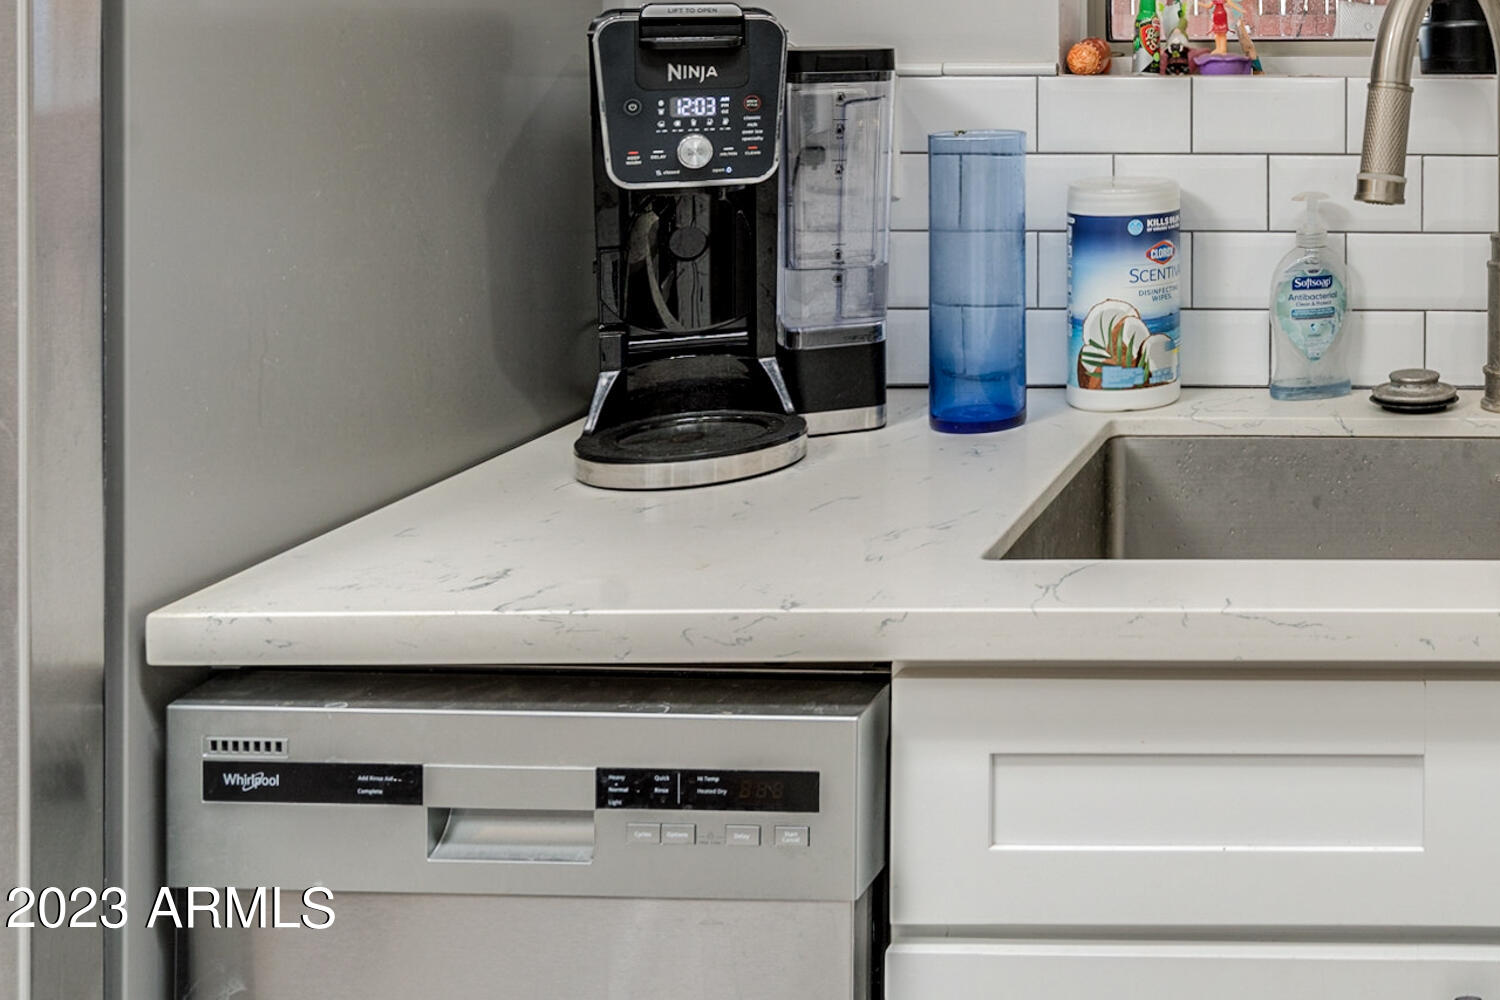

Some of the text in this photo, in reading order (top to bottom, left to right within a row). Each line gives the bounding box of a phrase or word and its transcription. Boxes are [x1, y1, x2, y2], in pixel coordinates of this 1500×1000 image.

[667, 63, 719, 84] NINJA
[676, 96, 717, 117] 12:03
[1294, 277, 1332, 289] Softsoap
[1151, 293, 1173, 303] WIPES
[1288, 291, 1339, 302] Antibacterial
[222, 772, 280, 792] Whirlpool
[654, 774, 671, 783] Quick
